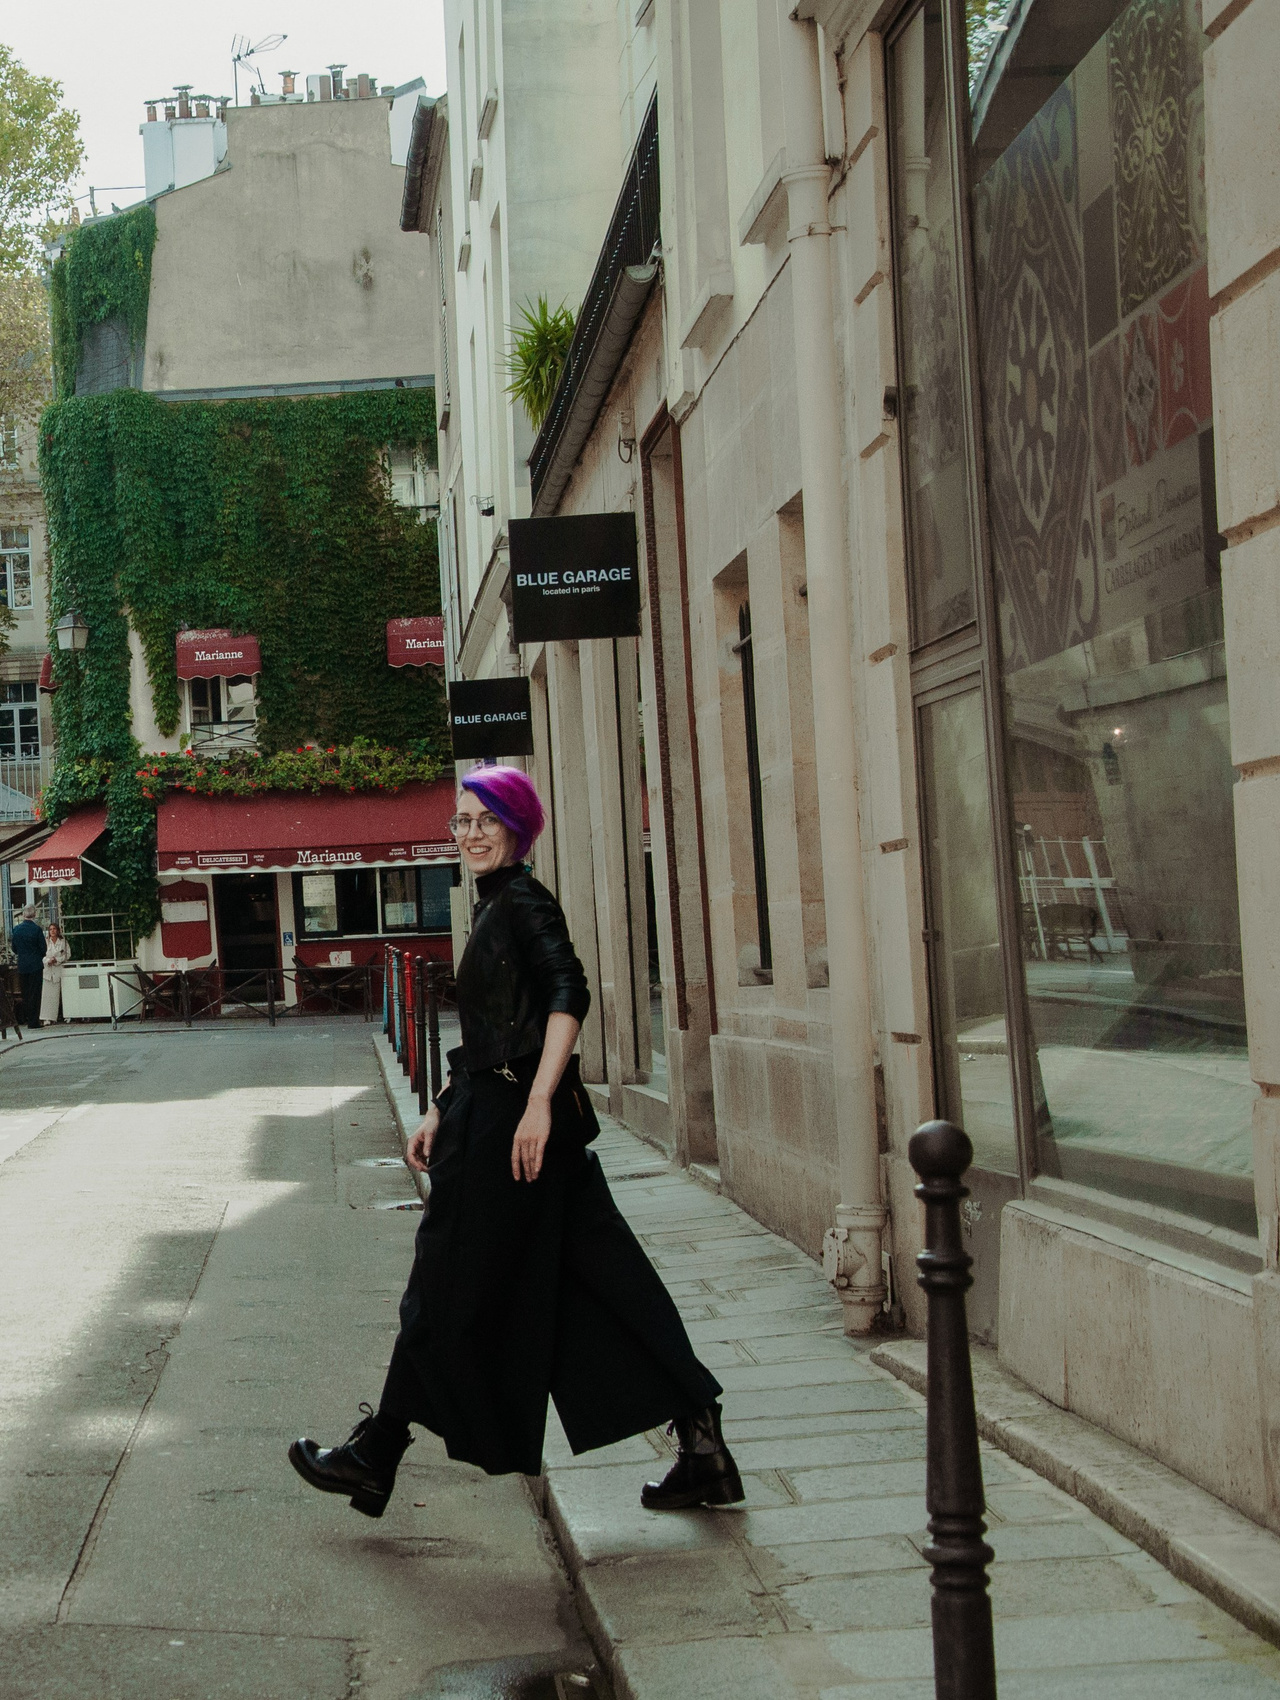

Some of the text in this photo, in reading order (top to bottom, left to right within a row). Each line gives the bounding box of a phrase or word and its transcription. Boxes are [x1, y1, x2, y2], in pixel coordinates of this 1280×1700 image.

[516, 567, 632, 587] BLUE GARAGE
[542, 585, 601, 596] located in paris
[405, 637, 445, 649] Marian
[194, 650, 244, 661] Marianne
[454, 711, 528, 725] BLUE GARAGE
[416, 846, 458, 854] DELICATESSEN
[202, 856, 243, 864] DELICATESSEN
[297, 850, 362, 863] Marianne
[32, 865, 76, 880] Marianne
